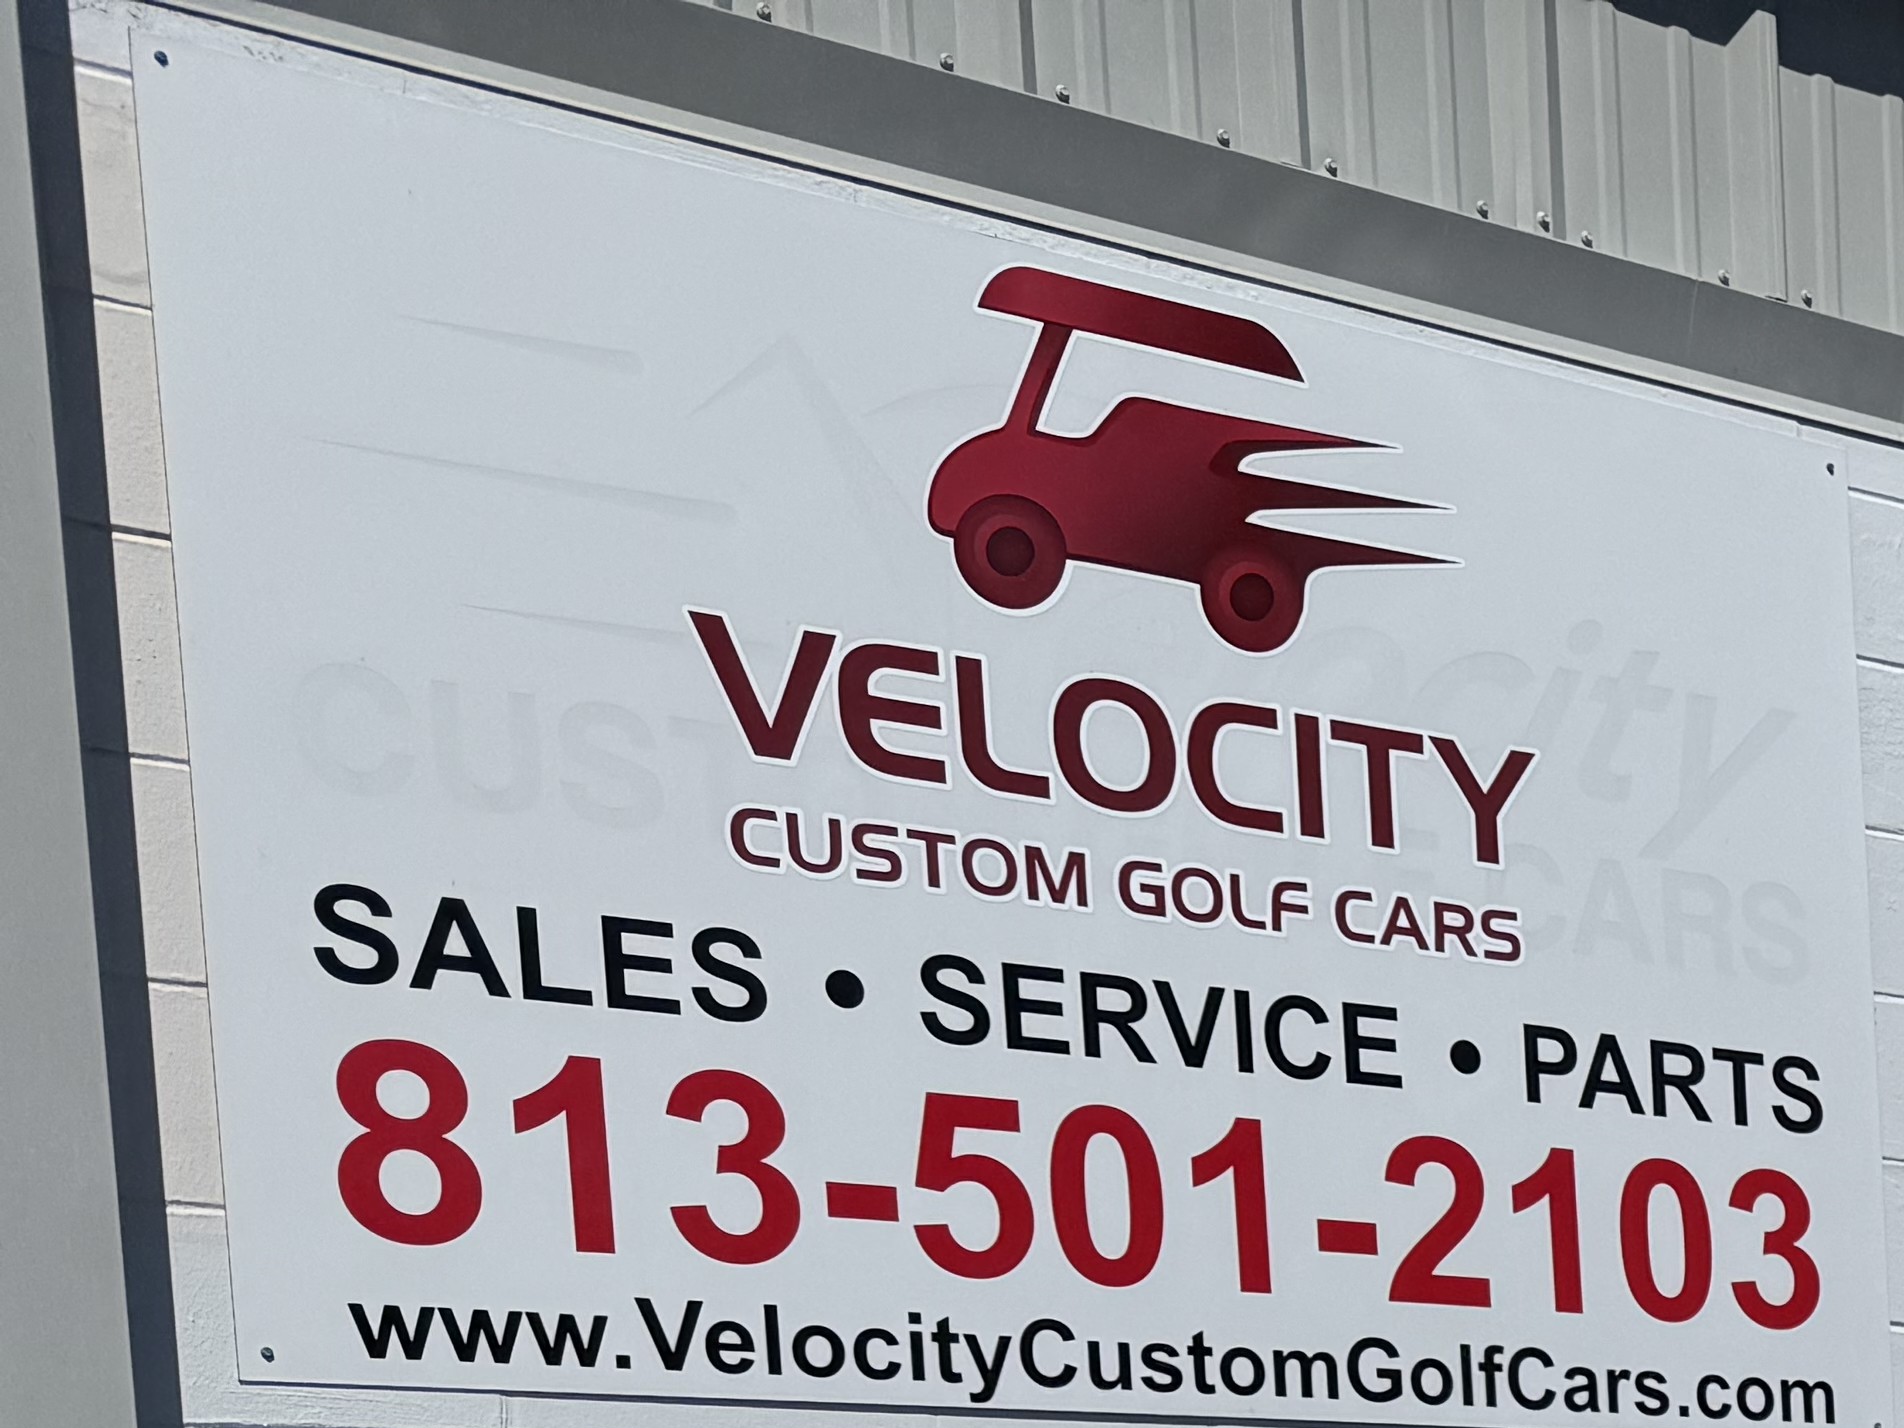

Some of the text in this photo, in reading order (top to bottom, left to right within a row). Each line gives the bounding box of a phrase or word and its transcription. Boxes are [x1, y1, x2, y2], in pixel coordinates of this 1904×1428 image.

[688, 611, 1536, 865] VELOCITY
[313, 883, 1824, 1134] SALES SERVICE PARTS
[730, 807, 1522, 963] CUSTOM GOLF CARS
[336, 1038, 1821, 1331] 813-501-2103
[347, 1297, 1836, 1425] www.VelocityCustomGolfCars.com
